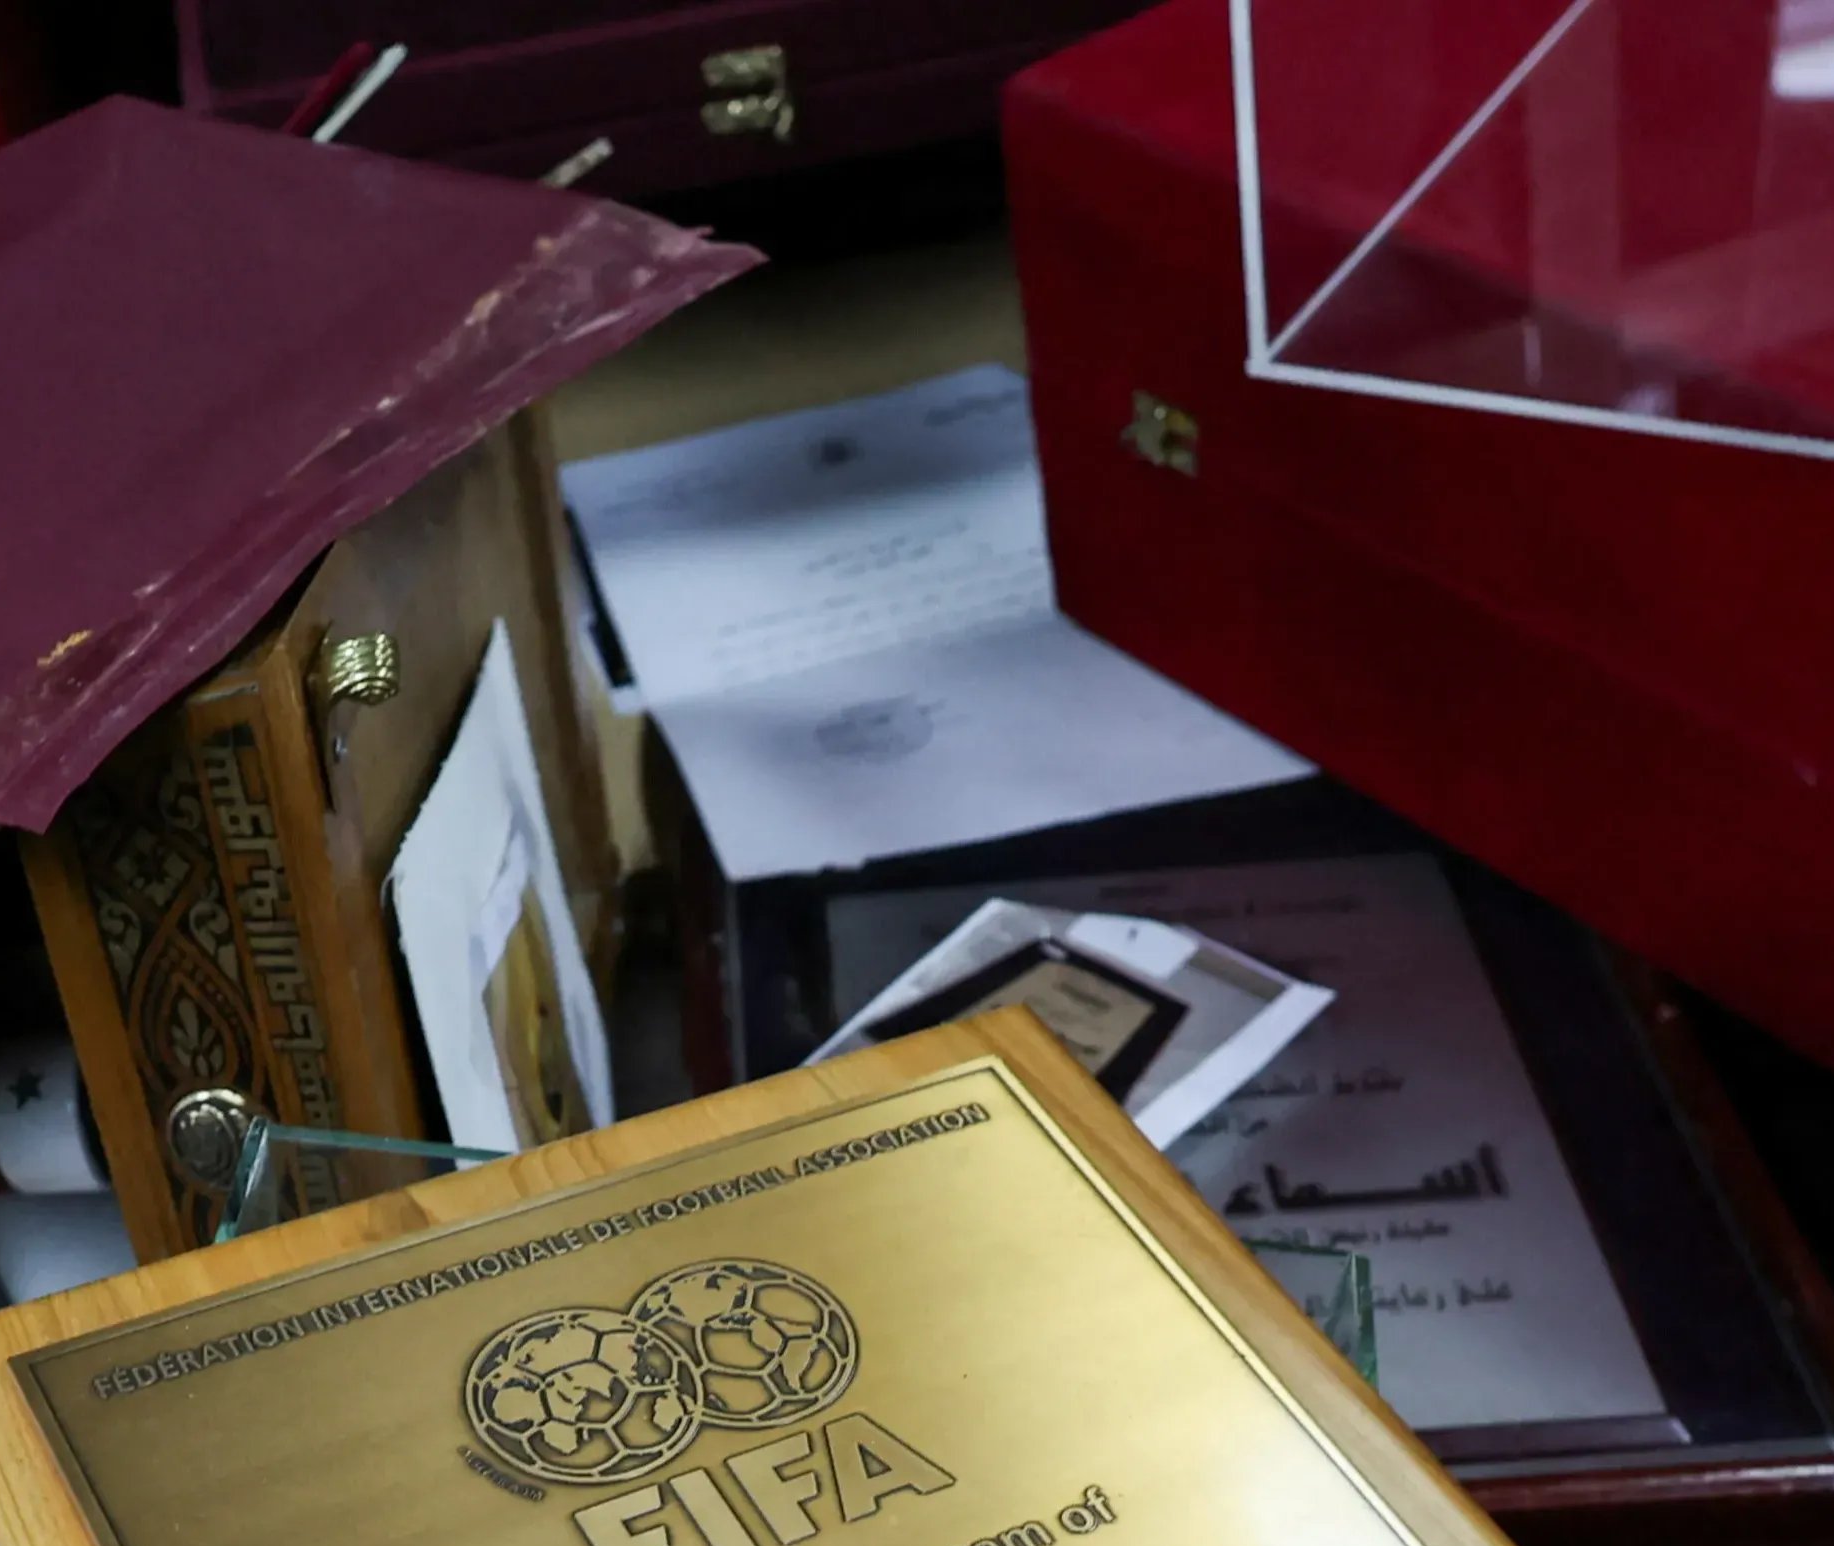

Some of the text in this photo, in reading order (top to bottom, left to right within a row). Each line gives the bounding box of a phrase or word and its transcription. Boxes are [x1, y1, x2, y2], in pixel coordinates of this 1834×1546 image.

[92, 1103, 990, 1399] FÉDÉRATION INTERNATIONALE DE FOOTBALL ASSOCIATION
[1058, 1487, 1117, 1536] of
